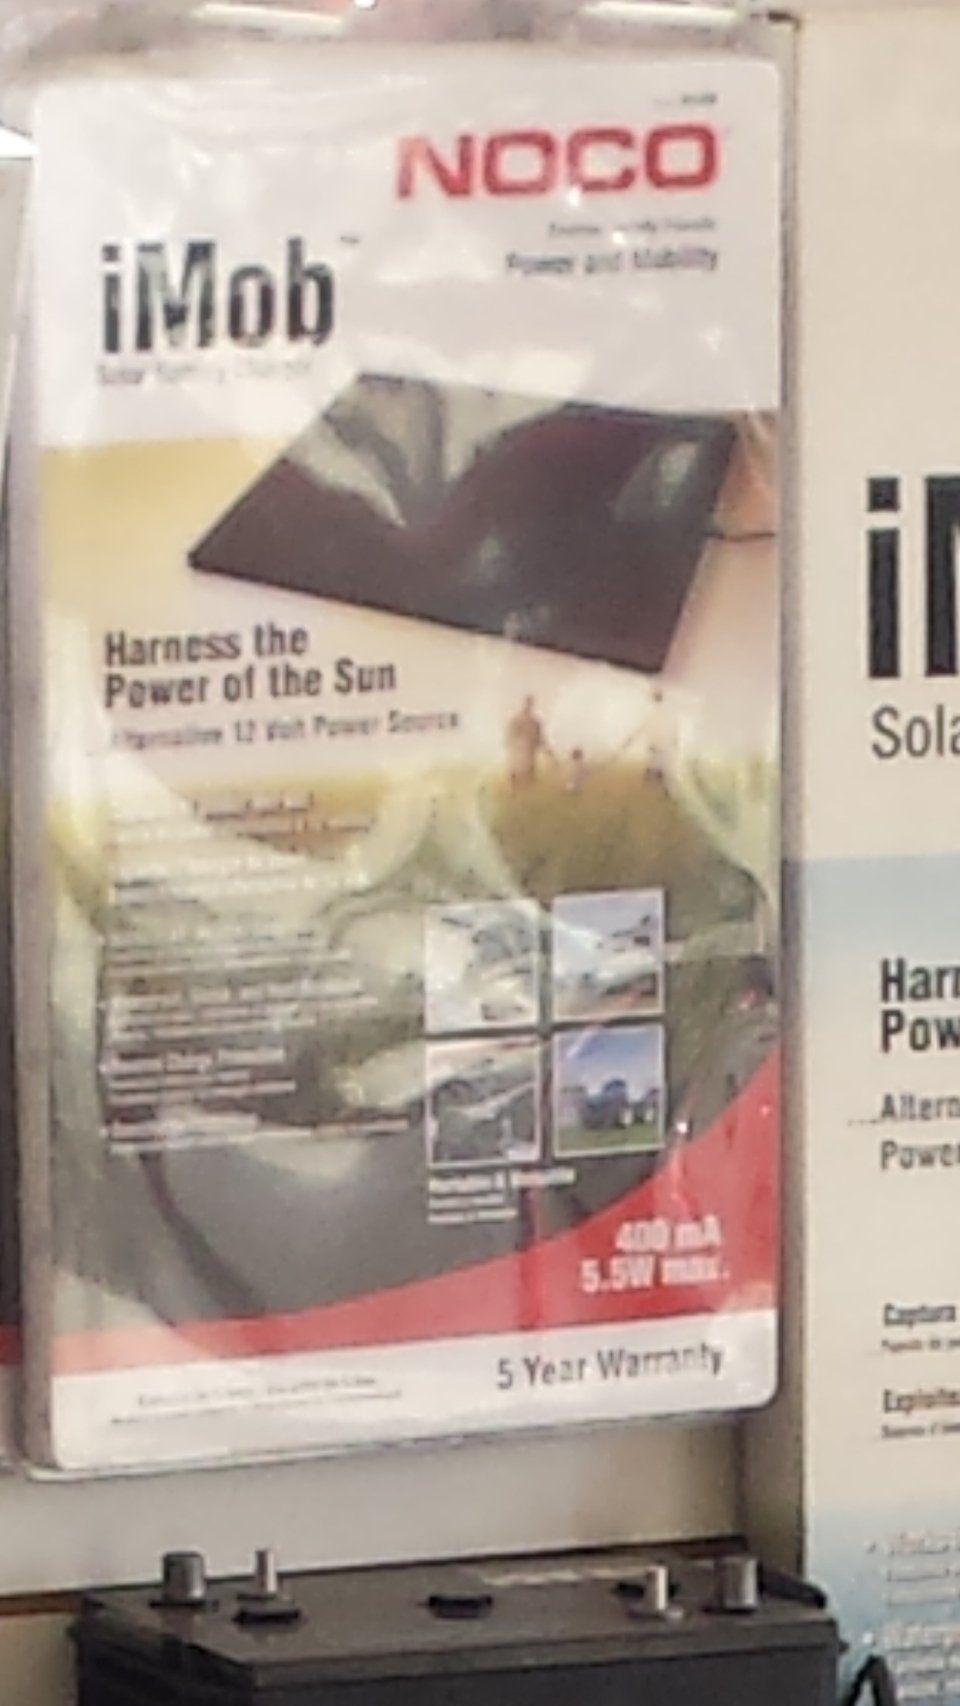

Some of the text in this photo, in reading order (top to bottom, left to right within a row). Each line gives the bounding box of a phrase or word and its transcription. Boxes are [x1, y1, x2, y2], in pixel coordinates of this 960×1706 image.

[398, 124, 718, 200] NOCO
[506, 252, 573, 277] Power
[100, 235, 334, 354] iMob
[104, 622, 308, 666] Harness the
[104, 656, 398, 708] Power of the Sun
[313, 713, 380, 737] Power
[615, 1213, 722, 1253] 400 mA
[578, 1255, 655, 1294] 5.5W
[496, 1342, 724, 1390] 5 Year Warranty
